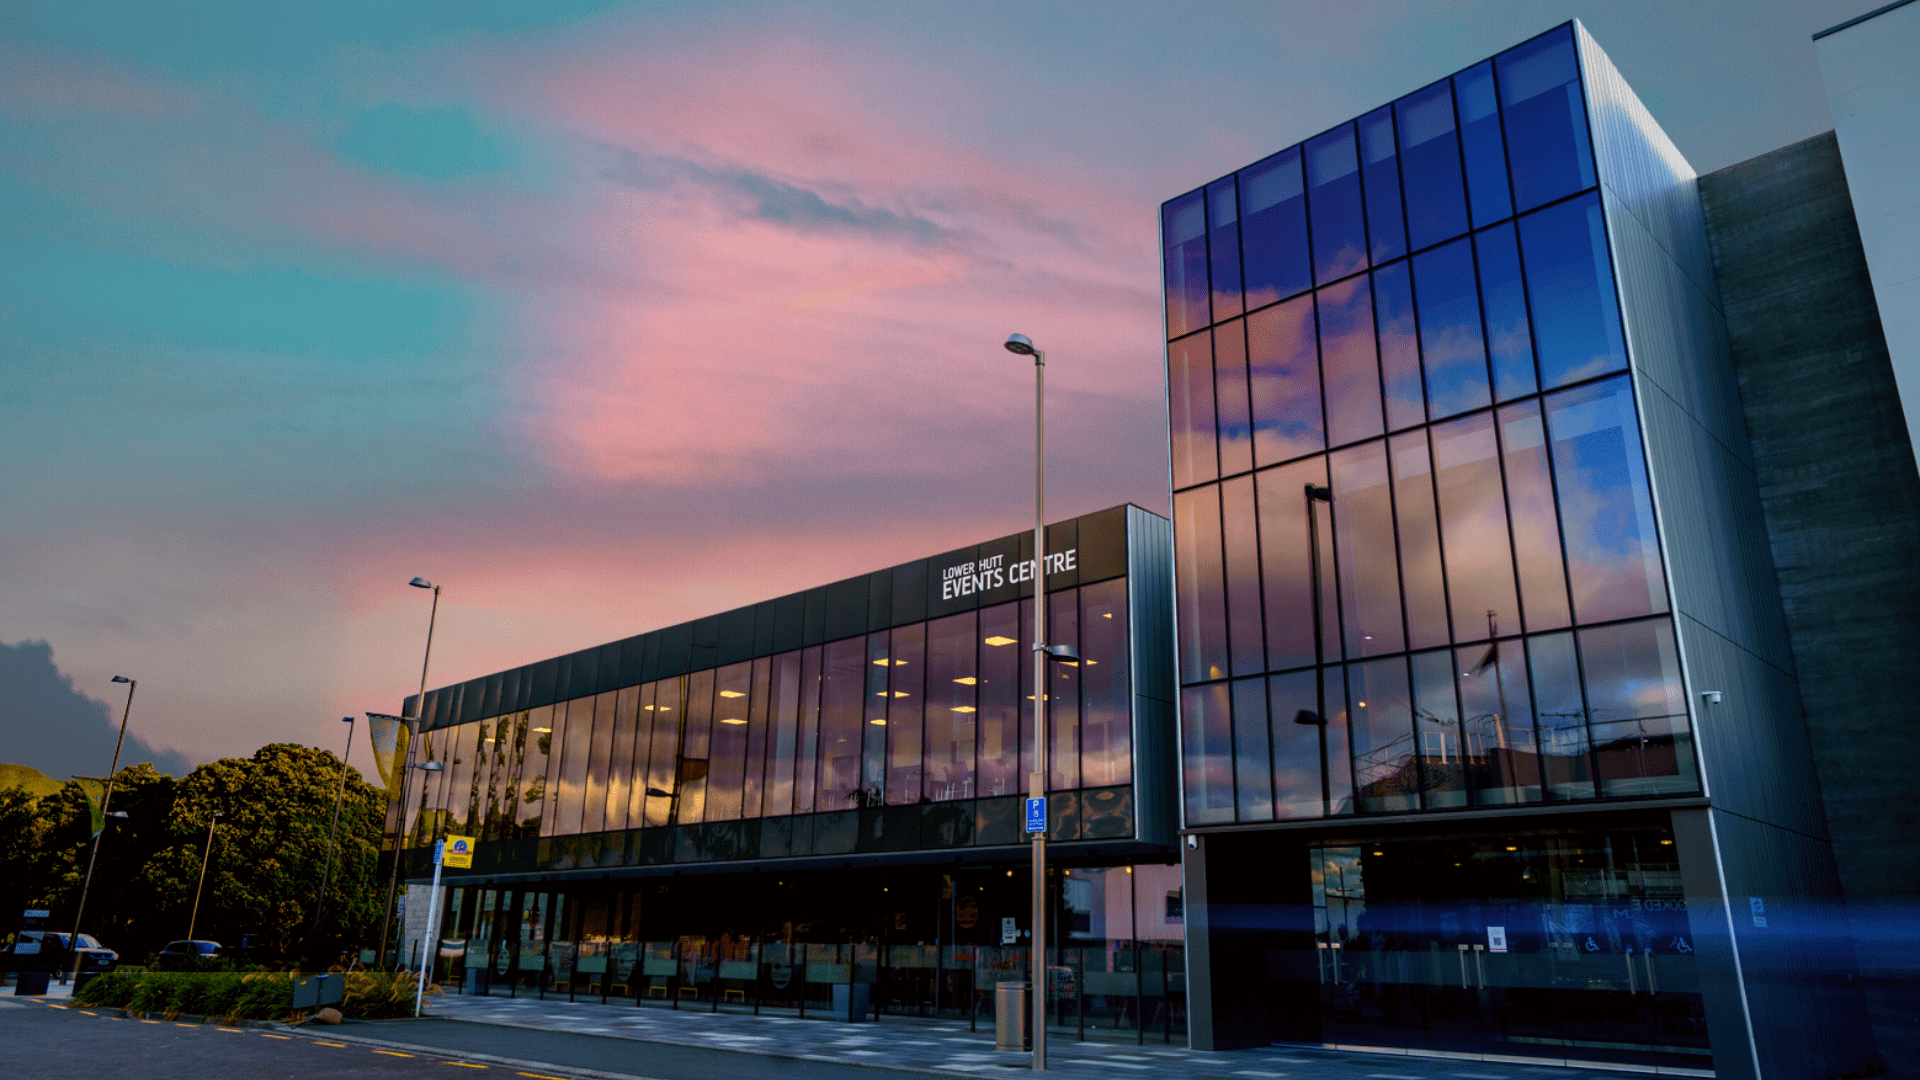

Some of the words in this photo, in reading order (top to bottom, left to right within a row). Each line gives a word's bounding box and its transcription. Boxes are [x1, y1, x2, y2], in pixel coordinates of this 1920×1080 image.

[943, 562, 975, 580] LOWER
[979, 554, 1004, 571] HUTT
[943, 568, 1004, 600] EVENTS
